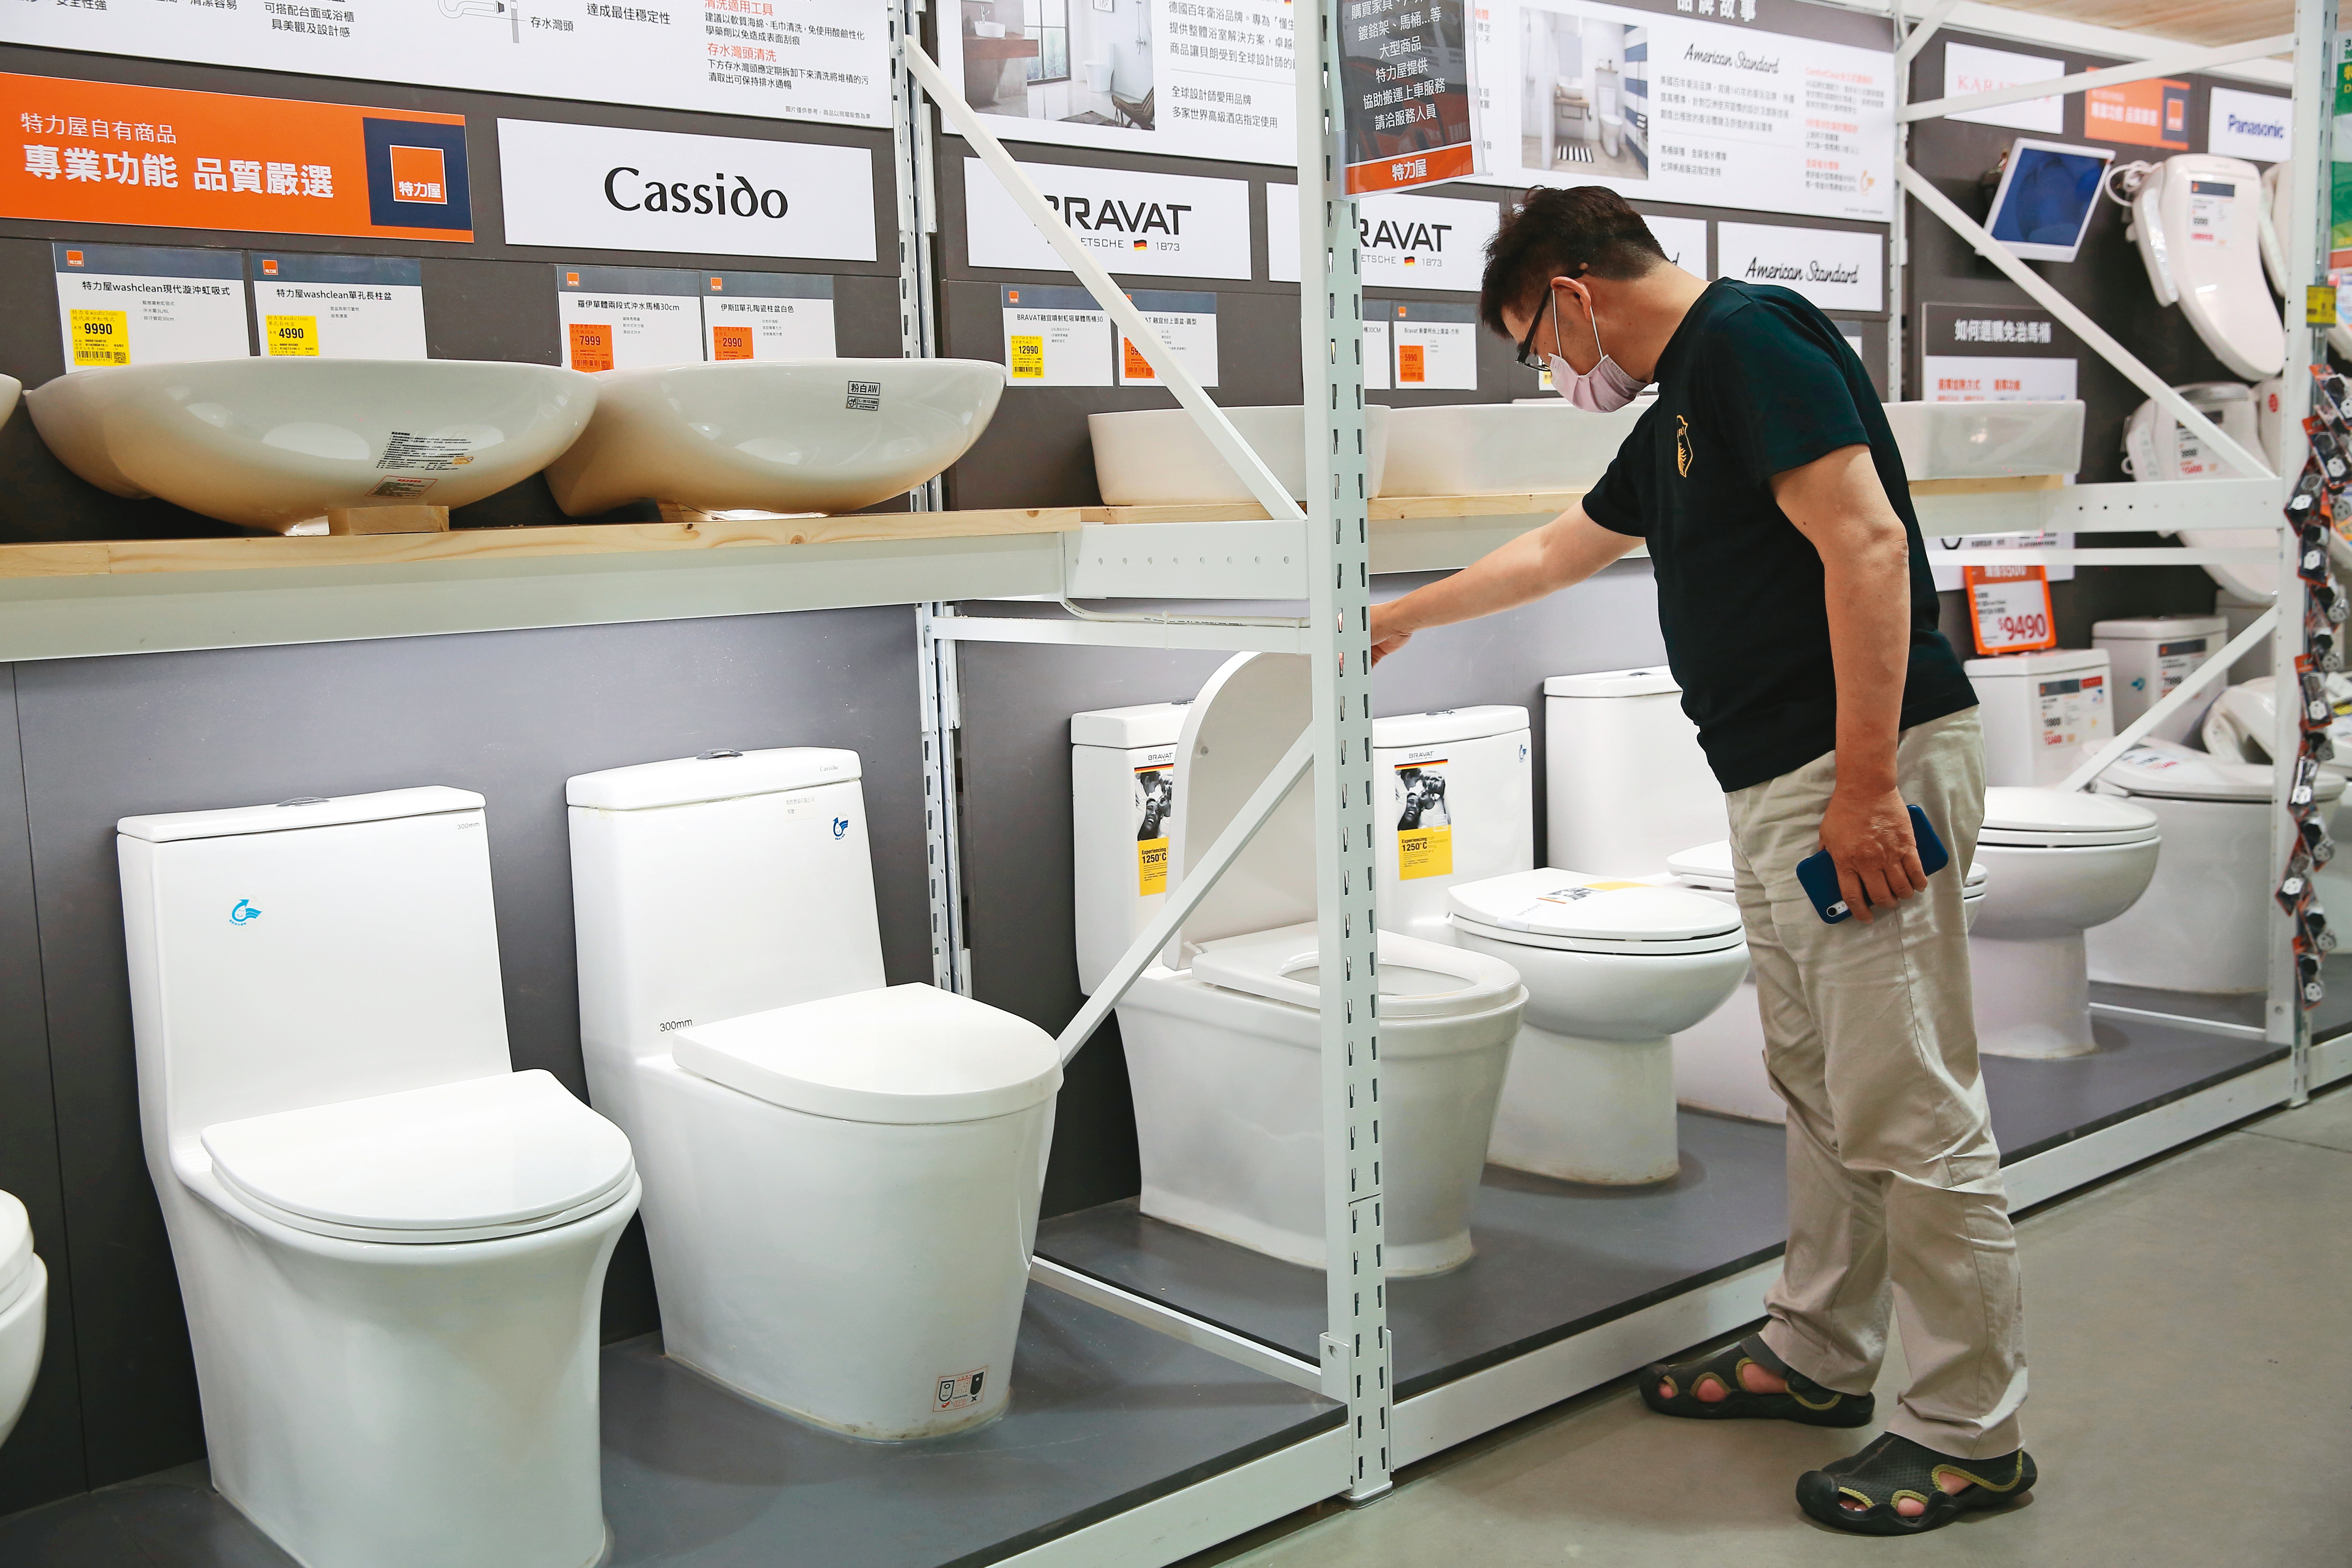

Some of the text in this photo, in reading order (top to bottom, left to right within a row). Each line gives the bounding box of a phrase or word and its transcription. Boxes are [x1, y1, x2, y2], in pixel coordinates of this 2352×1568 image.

[265, 2, 354, 22] 可搭配台面或浴櫃
[587, 2, 670, 25] 達成最佳穩定性
[272, 19, 350, 38] 具美觀及設計感
[530, 17, 574, 32] 存水灣頭
[706, 25, 800, 45] 學藥劑以免造成表面刮痕
[1169, 21, 1294, 50] 提供整體浴室解決方案，卓越
[708, 43, 776, 62] 存水灣頭清洗
[1380, 36, 1421, 59] 大型商品
[1684, 43, 1780, 74] American Standard
[1376, 58, 1428, 83] 特力屋提供
[708, 72, 792, 90] 漬取出可保持排水通暢
[1172, 85, 1251, 106] 全球設計師愛用品牌
[1363, 77, 1445, 110] 協助搬運上車服務
[1172, 106, 1278, 129] 多家世界高級酒店指定使用
[1375, 103, 1437, 130] 請洽服務人員
[21, 113, 176, 144] 特力屋自有商品
[2228, 114, 2283, 139] Panasonic
[23, 144, 334, 198] 專業功能 品質嚴選
[1392, 159, 1427, 181] 特力屋
[398, 180, 441, 198] 特力屋
[604, 167, 788, 219] Cassido
[1360, 218, 1452, 252] RAVAT
[1156, 242, 1180, 251] 1873
[1422, 258, 1442, 267] 1873
[1745, 257, 1859, 283] American Standard
[82, 281, 230, 295] 特力屋washclean現代漩沖虹吸式
[277, 289, 392, 300] 特力屋washclean單孔長柱盆
[578, 300, 680, 311] 羅伊單體兩段式沖水馬桶30cm
[721, 304, 794, 313] 伊斯II單孔陶瓷柱盆白色
[85, 323, 112, 334] 9990
[279, 328, 304, 339] 4990
[579, 336, 601, 345] 7999
[722, 338, 742, 347] 2990
[1018, 346, 1038, 354] 12990
[851, 383, 878, 393] 粉白AW
[1148, 753, 1173, 761] BRAVAT
[660, 1019, 693, 1032] 300mm
